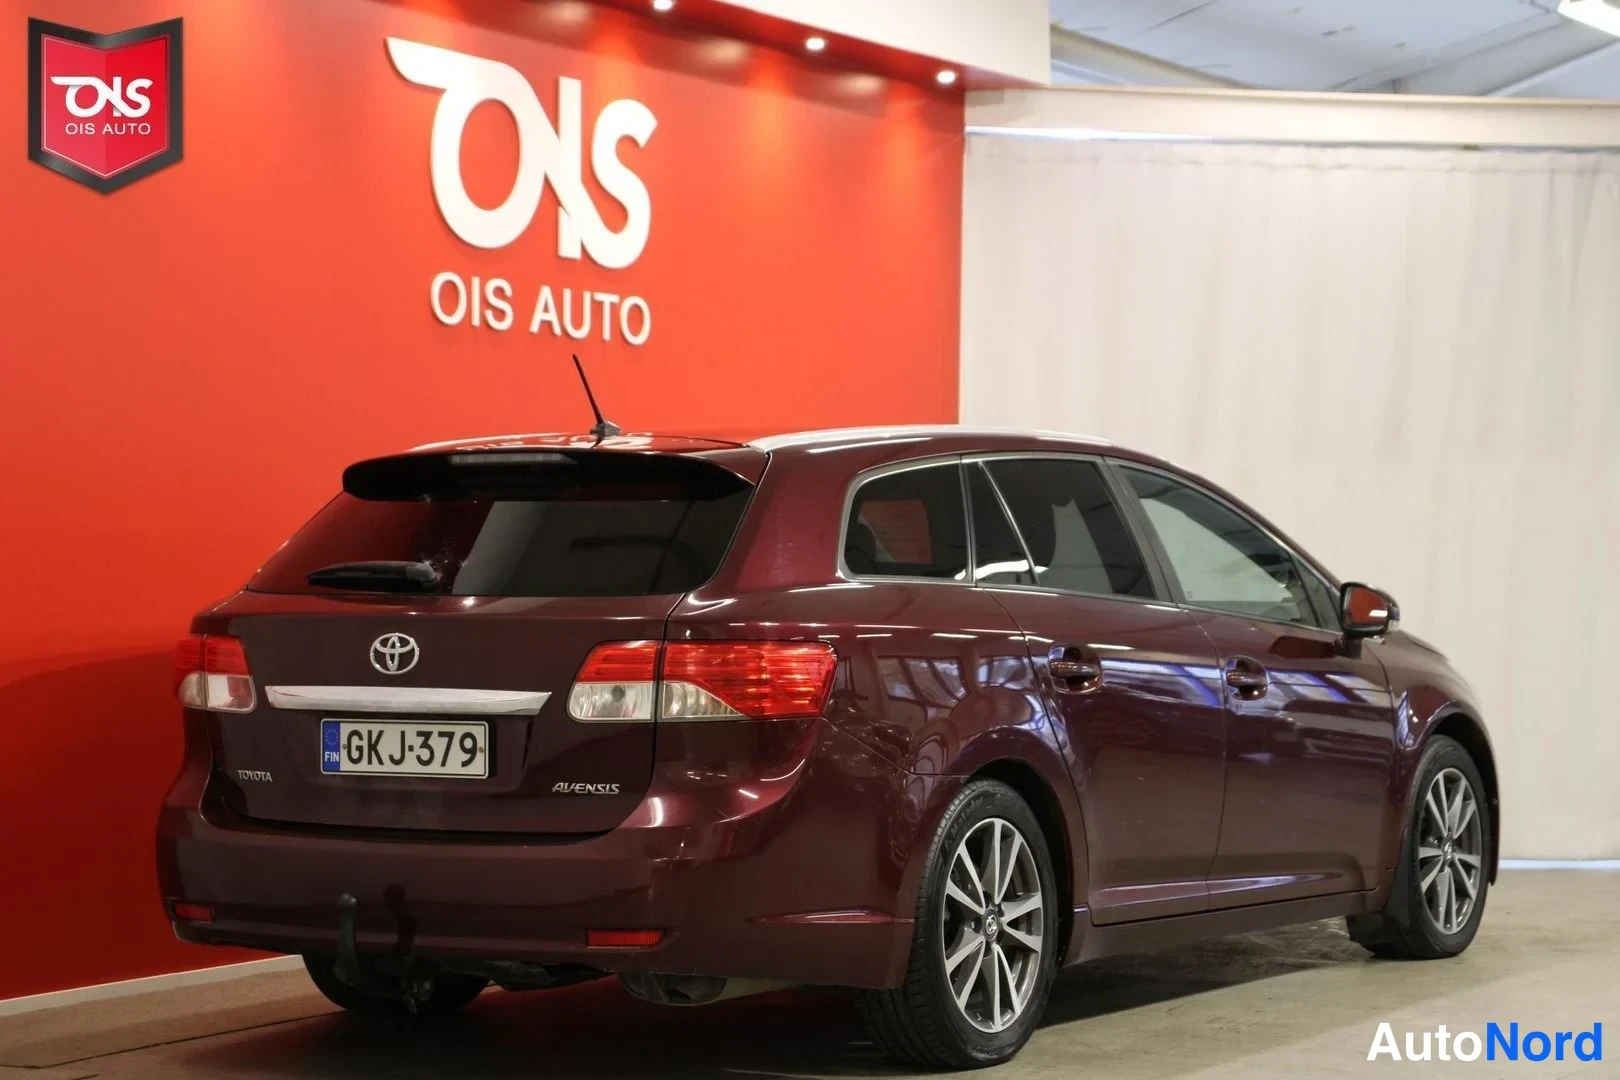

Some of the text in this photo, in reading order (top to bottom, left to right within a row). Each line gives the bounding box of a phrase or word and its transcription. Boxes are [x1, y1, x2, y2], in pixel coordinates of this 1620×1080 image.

[385, 36, 658, 269] OIS
[431, 271, 651, 345] OIS AUTO
[324, 751, 340, 763] FIN
[346, 729, 478, 768] GKJ-379
[237, 769, 273, 782] TOYOTA
[552, 782, 620, 795] AVENSIS
